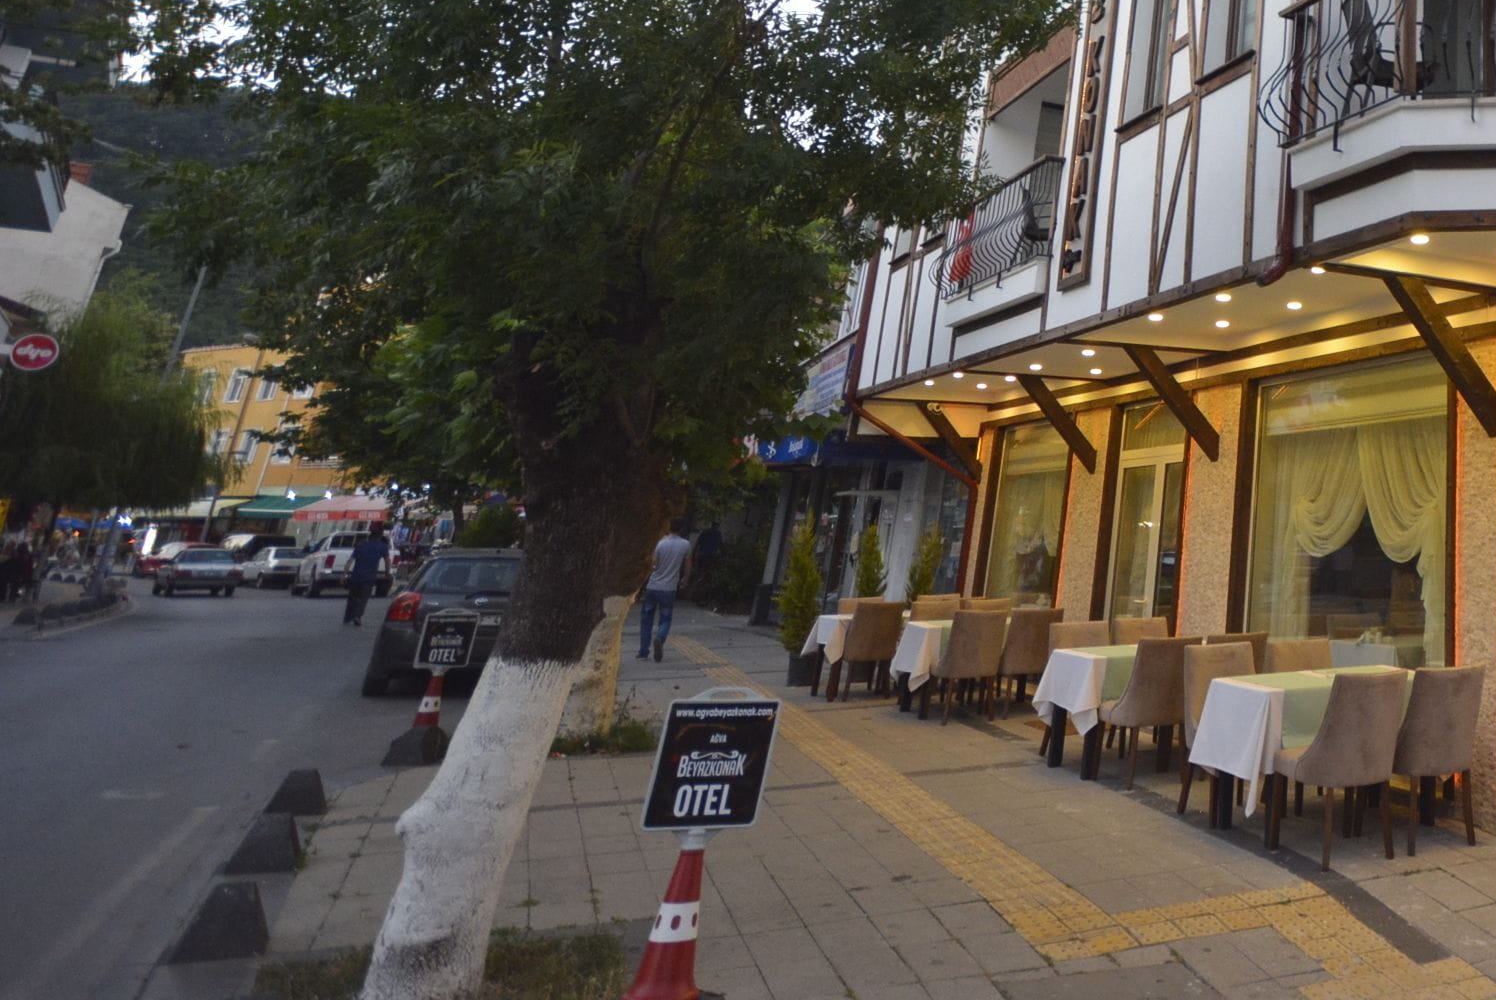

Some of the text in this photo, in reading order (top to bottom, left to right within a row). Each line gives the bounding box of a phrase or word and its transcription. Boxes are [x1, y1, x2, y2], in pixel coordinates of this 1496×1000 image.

[1067, 36, 1105, 240] KONAK
[428, 648, 456, 662] OTEL
[676, 754, 747, 778] BEYAZKONAK
[673, 784, 732, 818] OTEL
